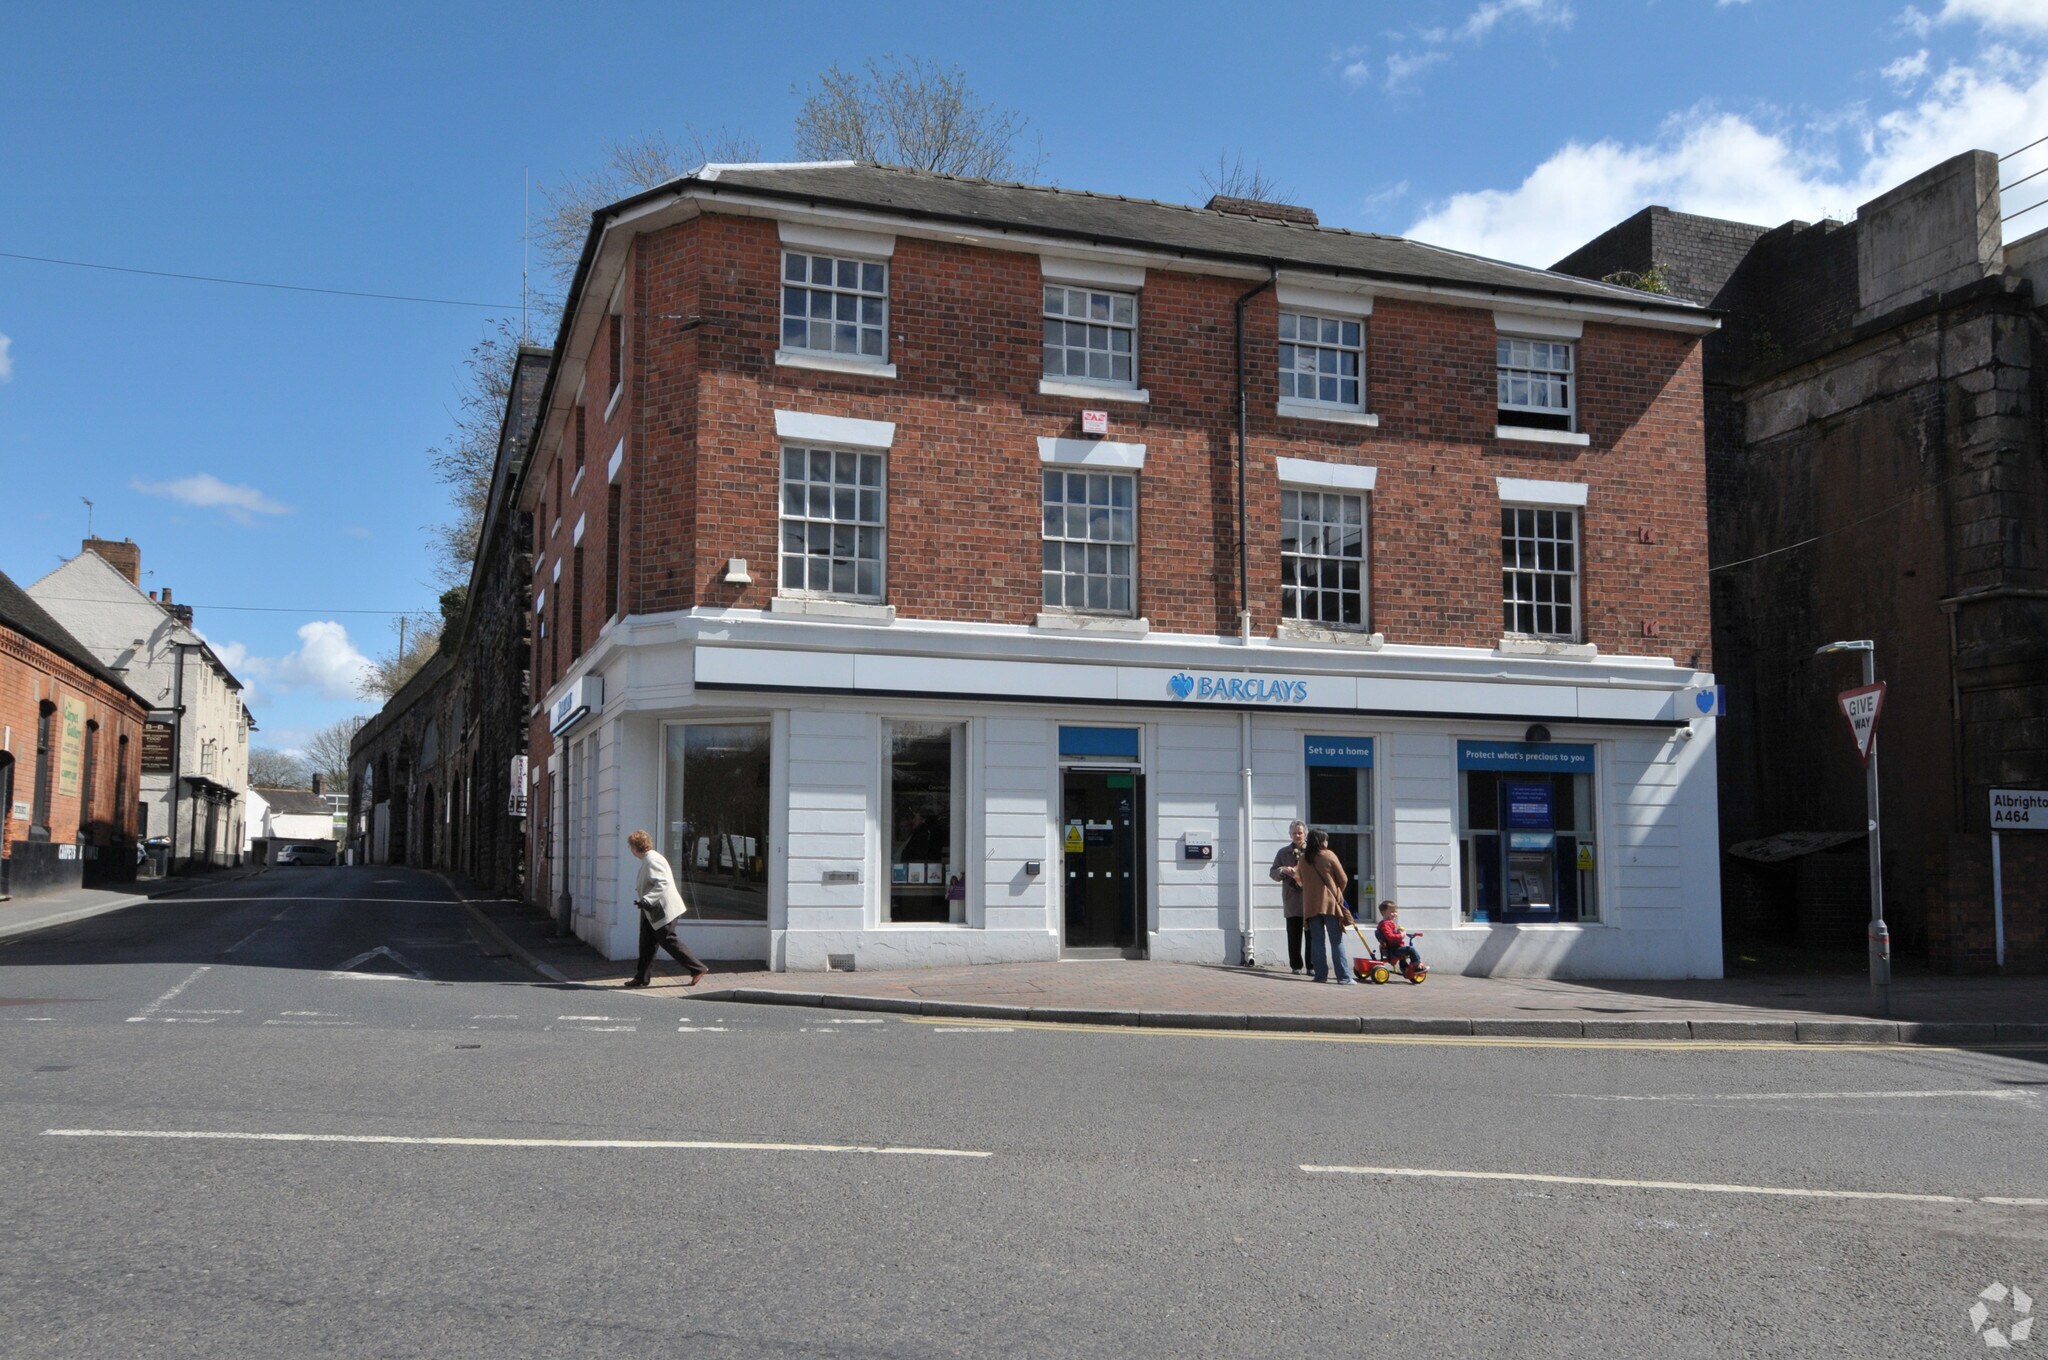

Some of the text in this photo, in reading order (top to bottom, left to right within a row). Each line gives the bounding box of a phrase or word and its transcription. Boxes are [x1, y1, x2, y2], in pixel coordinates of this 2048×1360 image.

[1199, 677, 1307, 701] BARCLAYS
[1849, 696, 1874, 716] GIVE
[1855, 716, 1871, 730] WAY
[1308, 746, 1323, 754] Set
[1325, 748, 1336, 757] up
[1346, 747, 1369, 756] home
[1466, 750, 1495, 759] Protect
[1497, 751, 1524, 760] what's
[1525, 753, 1558, 762] precious
[1570, 755, 1585, 763] you
[1995, 810, 2029, 822] A464
